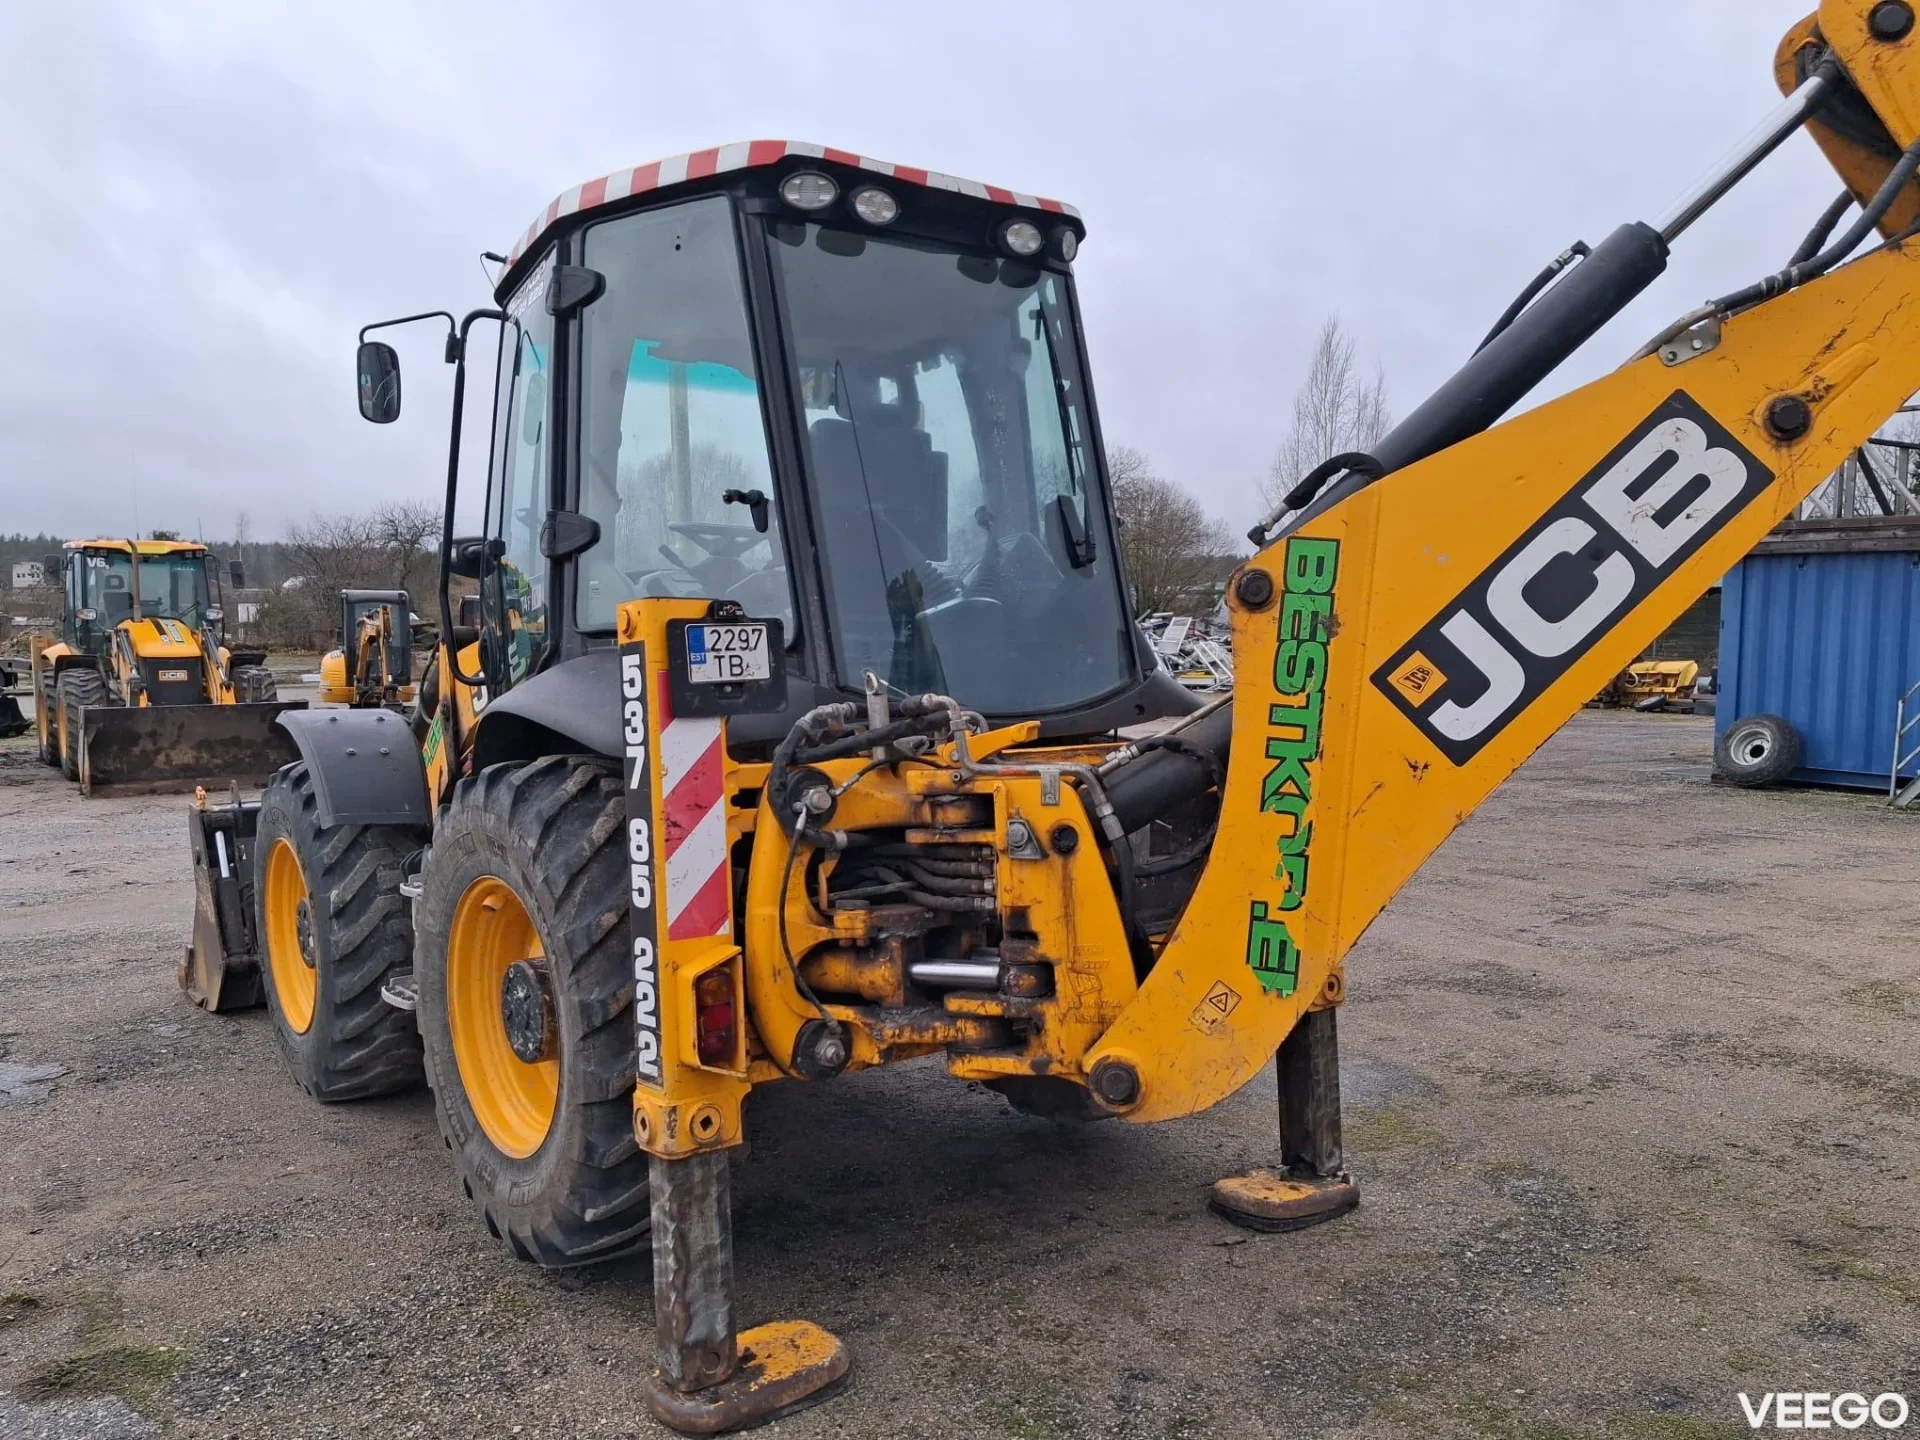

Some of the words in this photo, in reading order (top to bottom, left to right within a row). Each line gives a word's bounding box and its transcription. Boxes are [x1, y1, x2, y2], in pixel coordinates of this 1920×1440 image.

[1427, 416, 1748, 742] JCB
[691, 652, 706, 662] EST
[709, 627, 763, 652] 2297
[713, 654, 744, 678] TB
[1402, 667, 1431, 691] JCB
[621, 653, 645, 790] 537
[629, 818, 651, 909] 85
[634, 936, 659, 1079] 222
